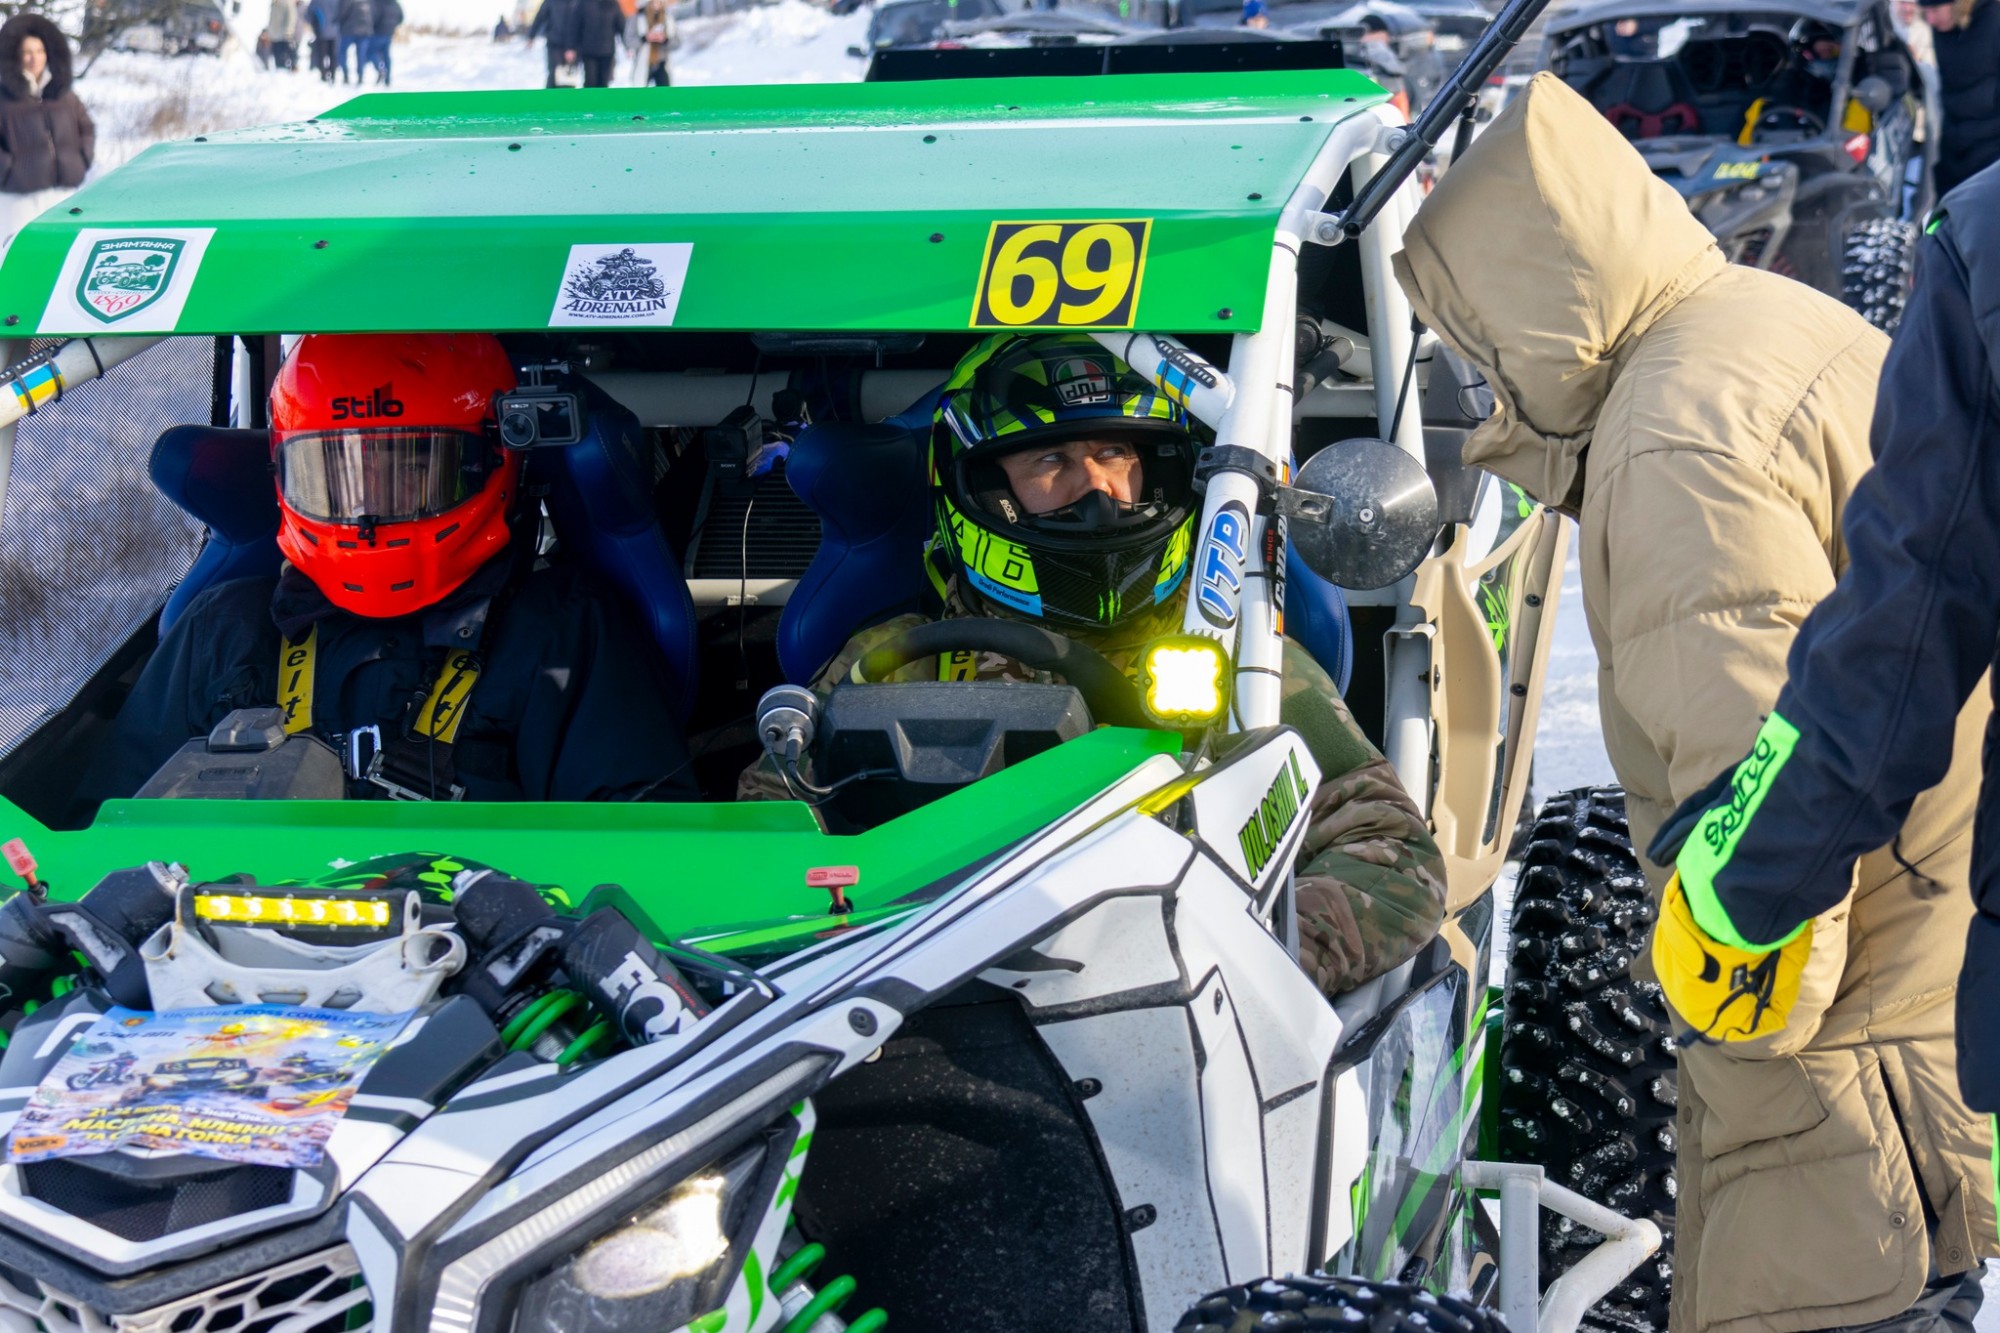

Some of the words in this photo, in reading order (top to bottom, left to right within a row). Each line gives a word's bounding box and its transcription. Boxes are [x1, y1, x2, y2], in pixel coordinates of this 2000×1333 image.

[987, 223, 1136, 325] 69
[600, 289, 640, 301] ATV
[562, 298, 667, 314] ADRENALIN
[1199, 510, 1246, 622] ITP
[1238, 760, 1299, 884] VOLOSHIN
[163, 1010, 231, 1019] UKRAINE
[234, 1008, 284, 1017] CROSS
[177, 1128, 252, 1144] ГОНКА
